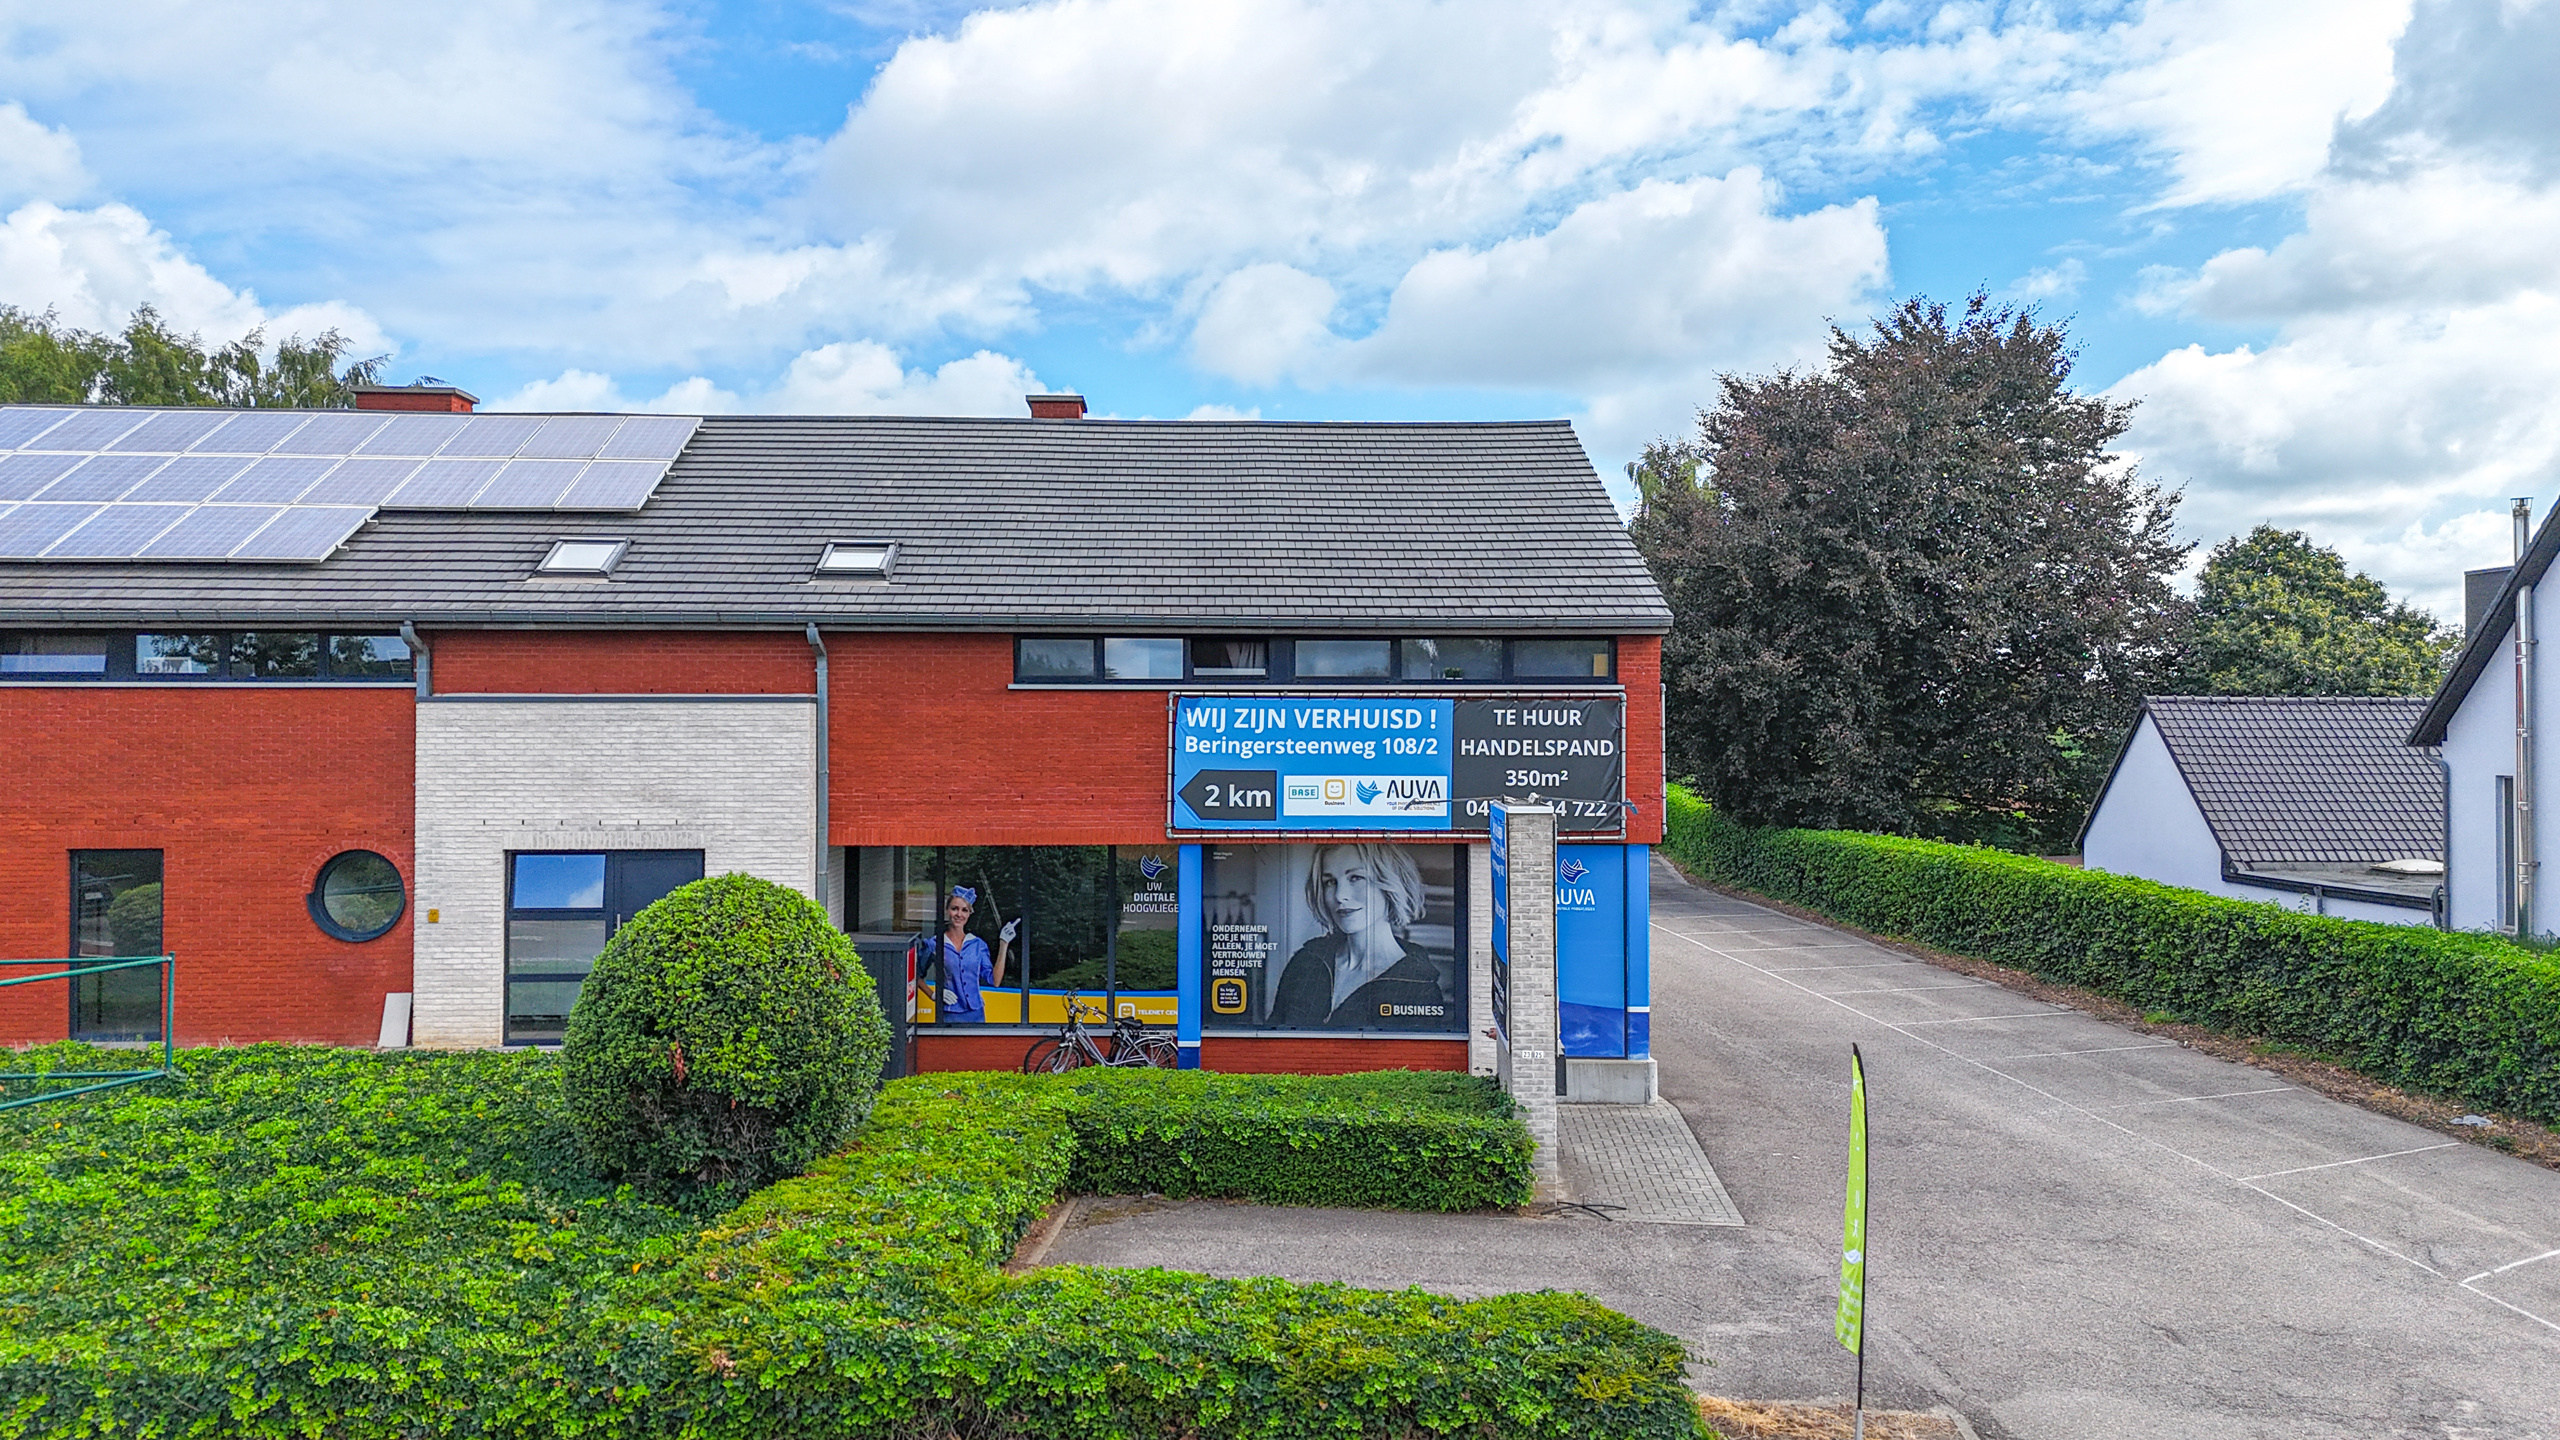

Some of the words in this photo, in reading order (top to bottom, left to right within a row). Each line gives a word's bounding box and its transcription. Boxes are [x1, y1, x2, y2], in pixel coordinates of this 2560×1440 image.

[1186, 707, 1227, 733] WIJ
[1234, 708, 1286, 733] ZIJN
[1294, 708, 1422, 729] VERHUISD
[1430, 709, 1437, 729] !
[1493, 709, 1517, 726] TE
[1522, 709, 1583, 726] HUUR
[1185, 736, 1376, 759] Beringersteenweg
[1382, 738, 1438, 755] 108/2
[1461, 739, 1614, 756] HANDELSPAND
[1505, 770, 1569, 787] 350m²
[1291, 788, 1316, 796] BASE
[1387, 779, 1441, 799] AUVA
[1204, 787, 1221, 807] 2
[1229, 784, 1272, 807] km
[1572, 800, 1608, 817] 722
[1146, 882, 1163, 891] UW
[1133, 892, 1176, 902] DIGITALE
[1212, 925, 1268, 933] ONDERNEMEN
[1212, 933, 1229, 941] DOE
[1230, 933, 1239, 942] JE
[1240, 933, 1259, 941] NIET
[1212, 942, 1244, 951] ALLEEN,
[1245, 942, 1253, 951] JE
[1255, 942, 1278, 951] MOET
[1212, 951, 1266, 959] VERTROUWEN
[1236, 960, 1263, 968] JUISTE
[1212, 968, 1247, 976] MENSEN.
[1393, 1004, 1444, 1016] BUSINESS
